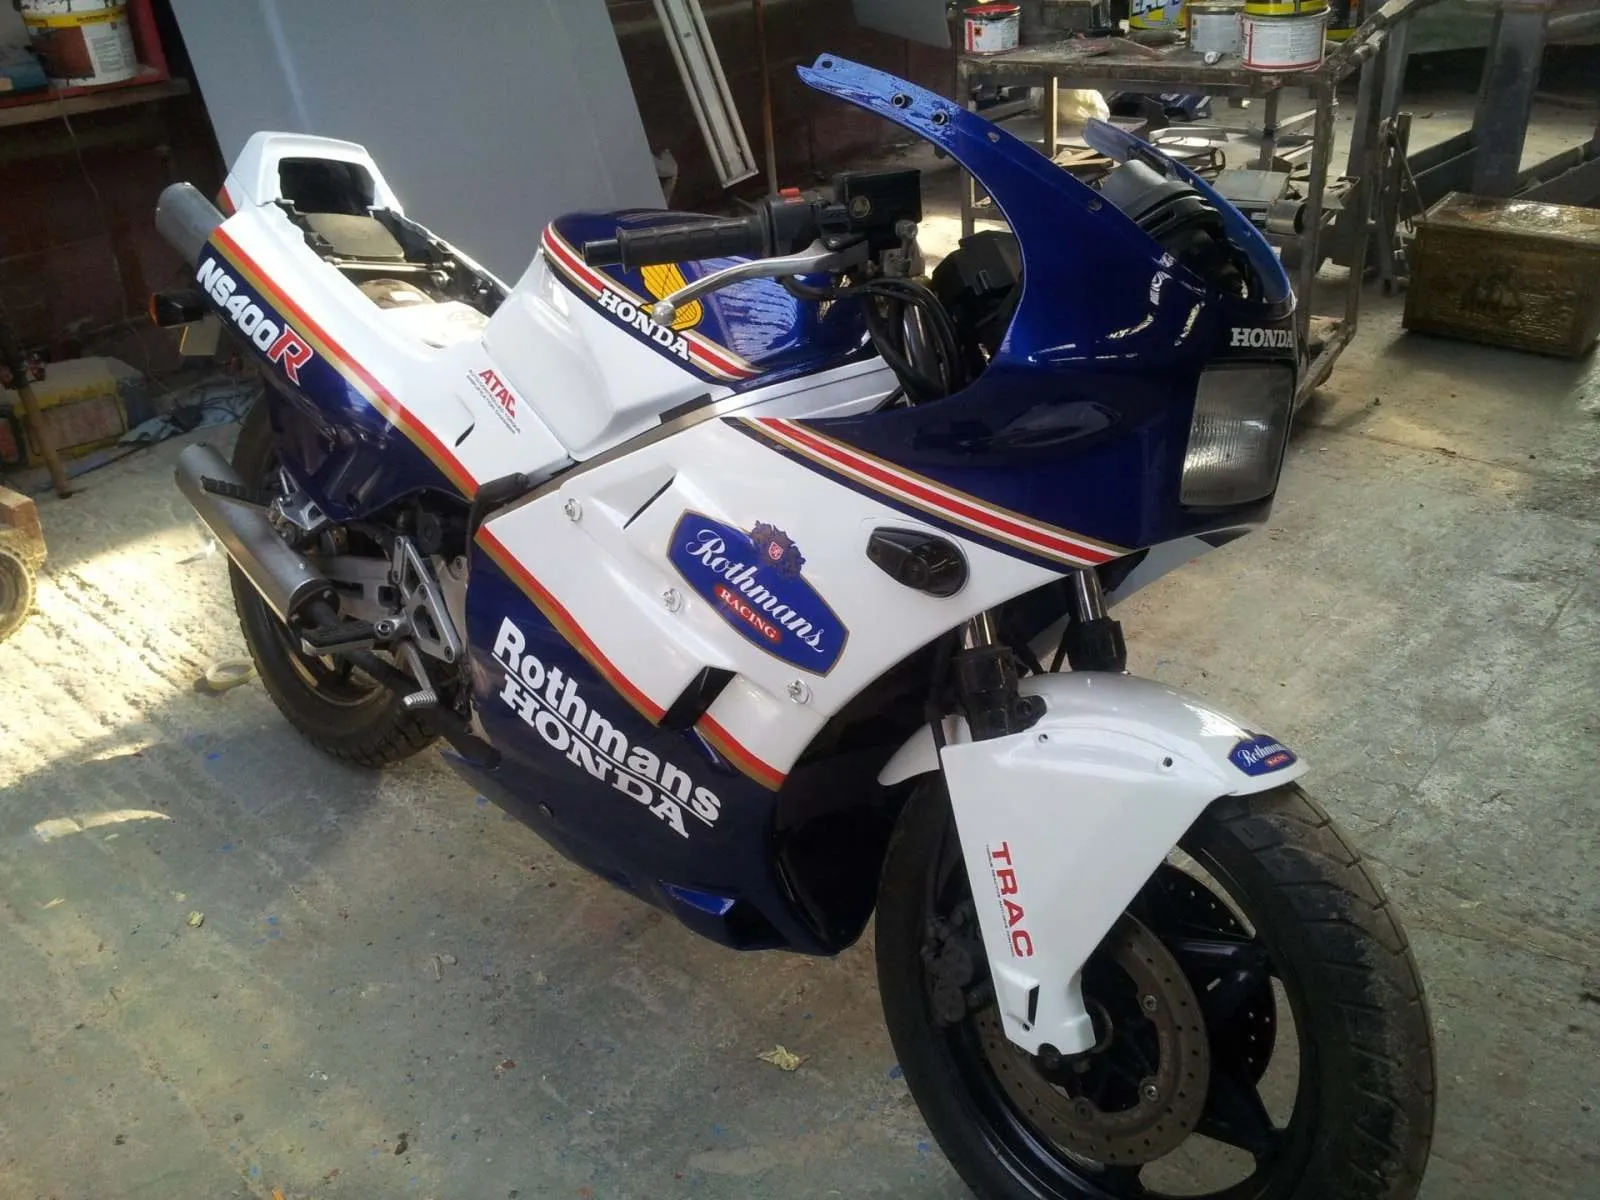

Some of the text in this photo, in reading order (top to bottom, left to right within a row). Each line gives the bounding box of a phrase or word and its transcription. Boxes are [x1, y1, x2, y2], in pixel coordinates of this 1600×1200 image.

[196, 257, 313, 387] NS400R
[598, 288, 689, 361] HONDA
[1229, 327, 1294, 349] HONDA
[479, 369, 516, 419] ATAC
[686, 529, 824, 653] Rothmans
[720, 588, 778, 639] RACING
[492, 616, 722, 821] Rothmans
[499, 674, 689, 838] HONDA
[992, 841, 1034, 958] TRAC
